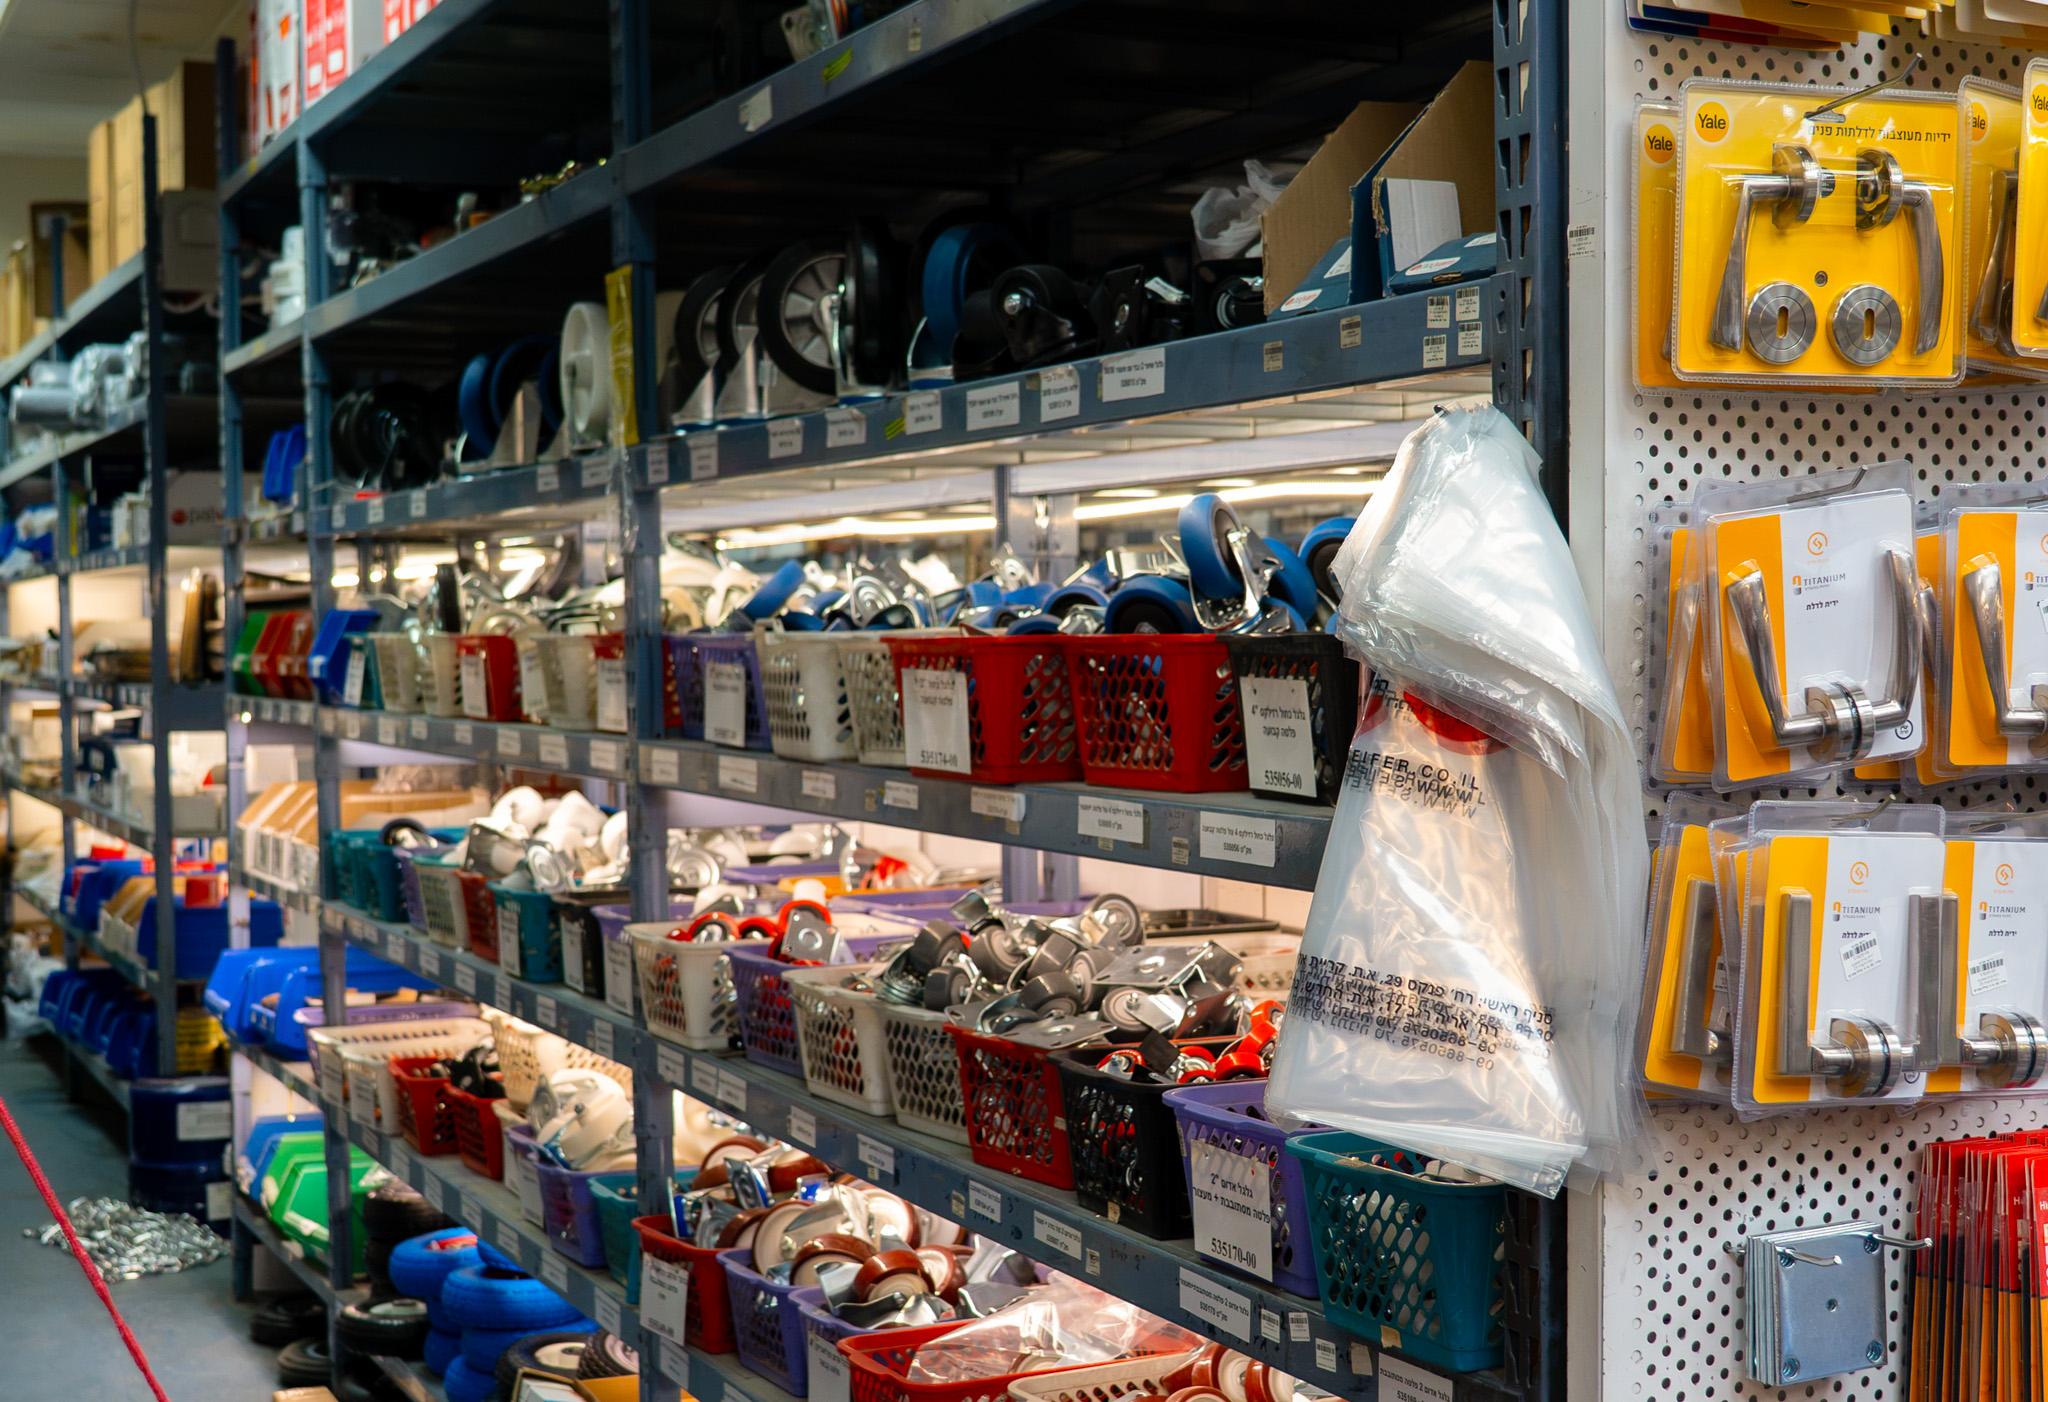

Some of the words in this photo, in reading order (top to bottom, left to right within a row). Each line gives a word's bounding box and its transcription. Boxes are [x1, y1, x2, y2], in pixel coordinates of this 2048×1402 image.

[1698, 113, 1727, 130] Yale
[1971, 114, 1986, 130] ale
[1647, 135, 1673, 151] Yale
[1804, 573, 1846, 586] TITANIUM
[1264, 770, 1302, 790] 535056-00
[1842, 906, 1880, 914] TITANIUM
[1989, 905, 2026, 914] TITANIUM
[1211, 1237, 1257, 1269] 535170-00
